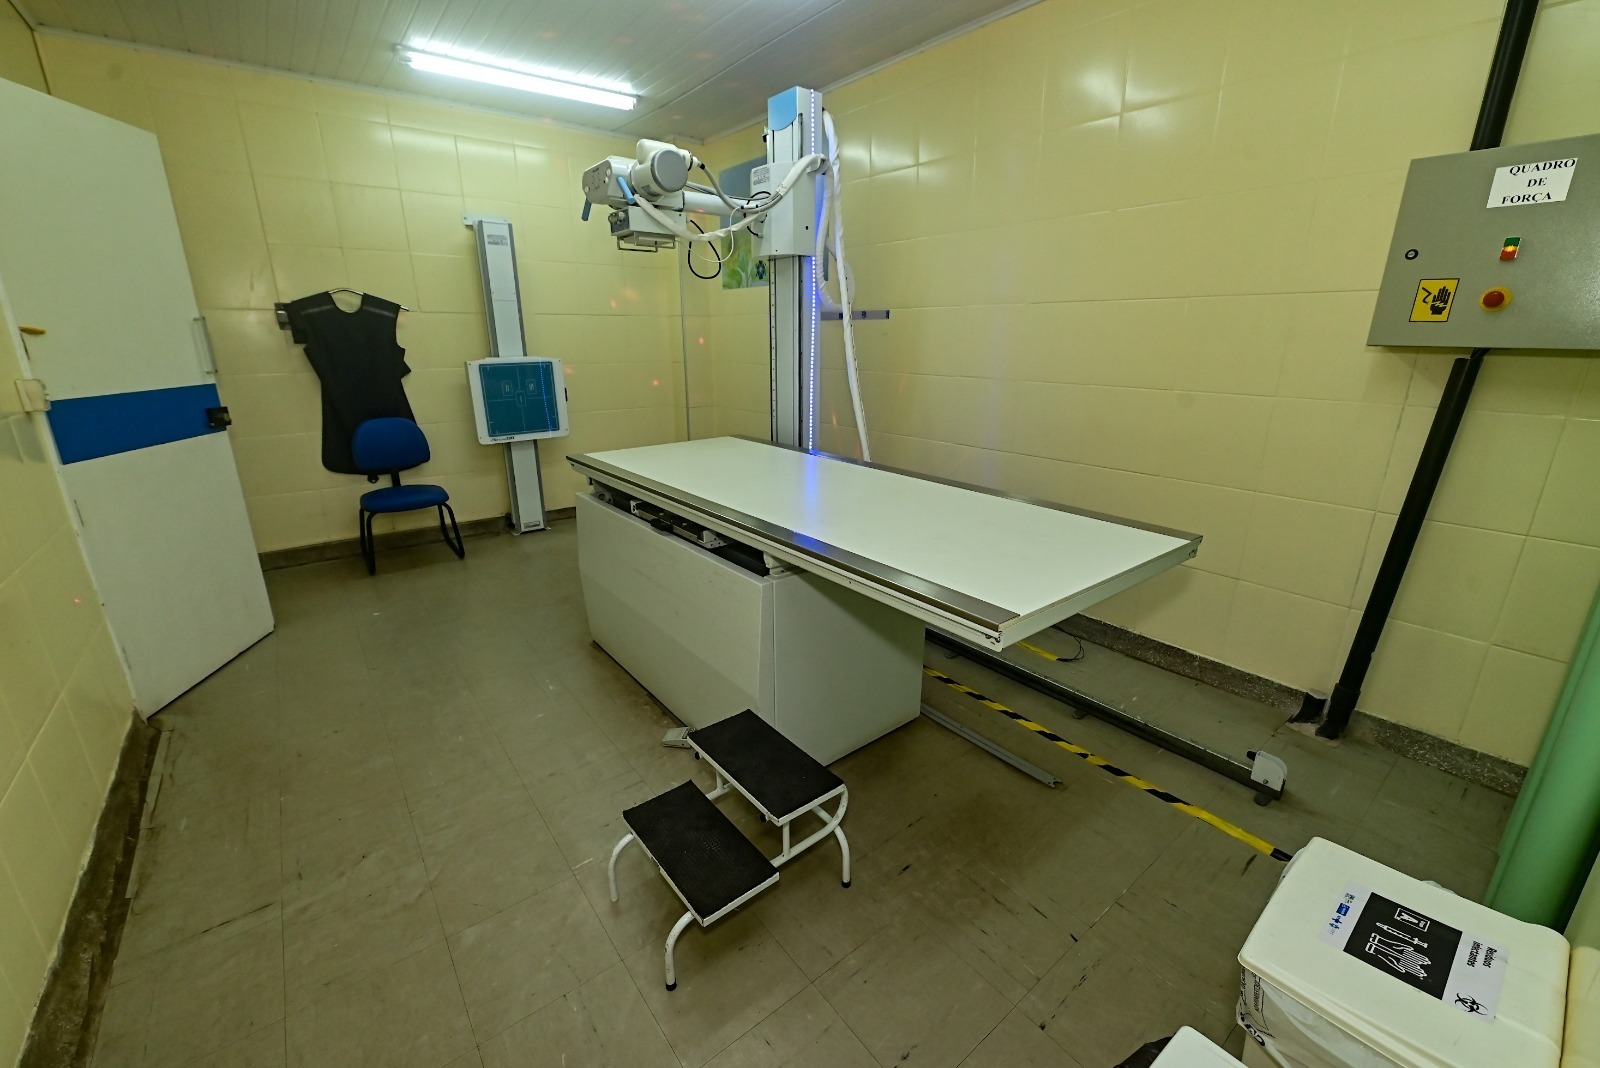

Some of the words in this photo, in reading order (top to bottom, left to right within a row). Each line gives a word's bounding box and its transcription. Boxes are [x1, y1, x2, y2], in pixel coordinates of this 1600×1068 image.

[1509, 158, 1576, 176] QUADRO
[1526, 177, 1548, 188] DE
[1501, 192, 1552, 205] FORÇA
